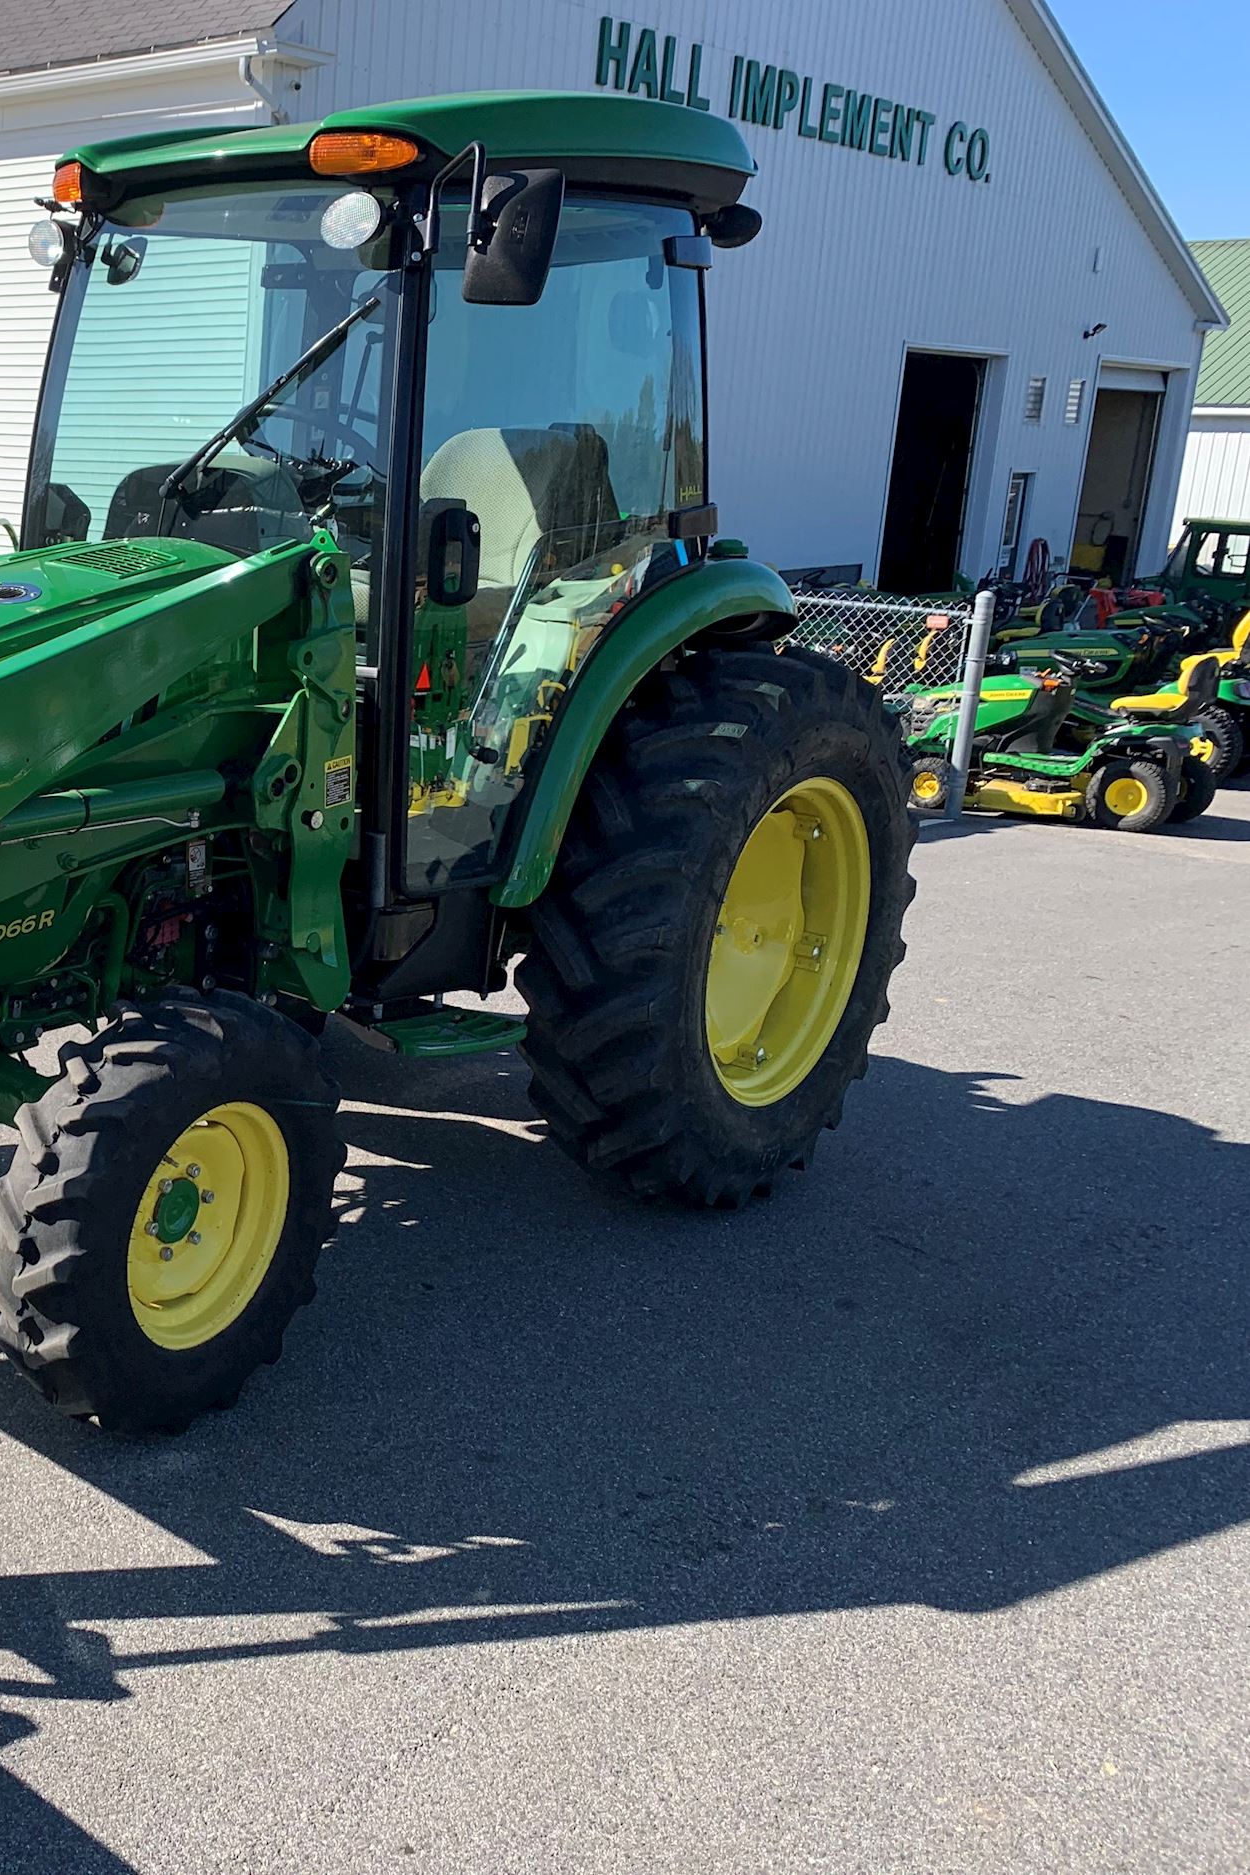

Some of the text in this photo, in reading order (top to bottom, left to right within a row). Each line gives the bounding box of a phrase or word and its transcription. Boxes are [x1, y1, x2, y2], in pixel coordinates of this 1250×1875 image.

[596, 16, 991, 183] HALL IMPLEMENT CO.
